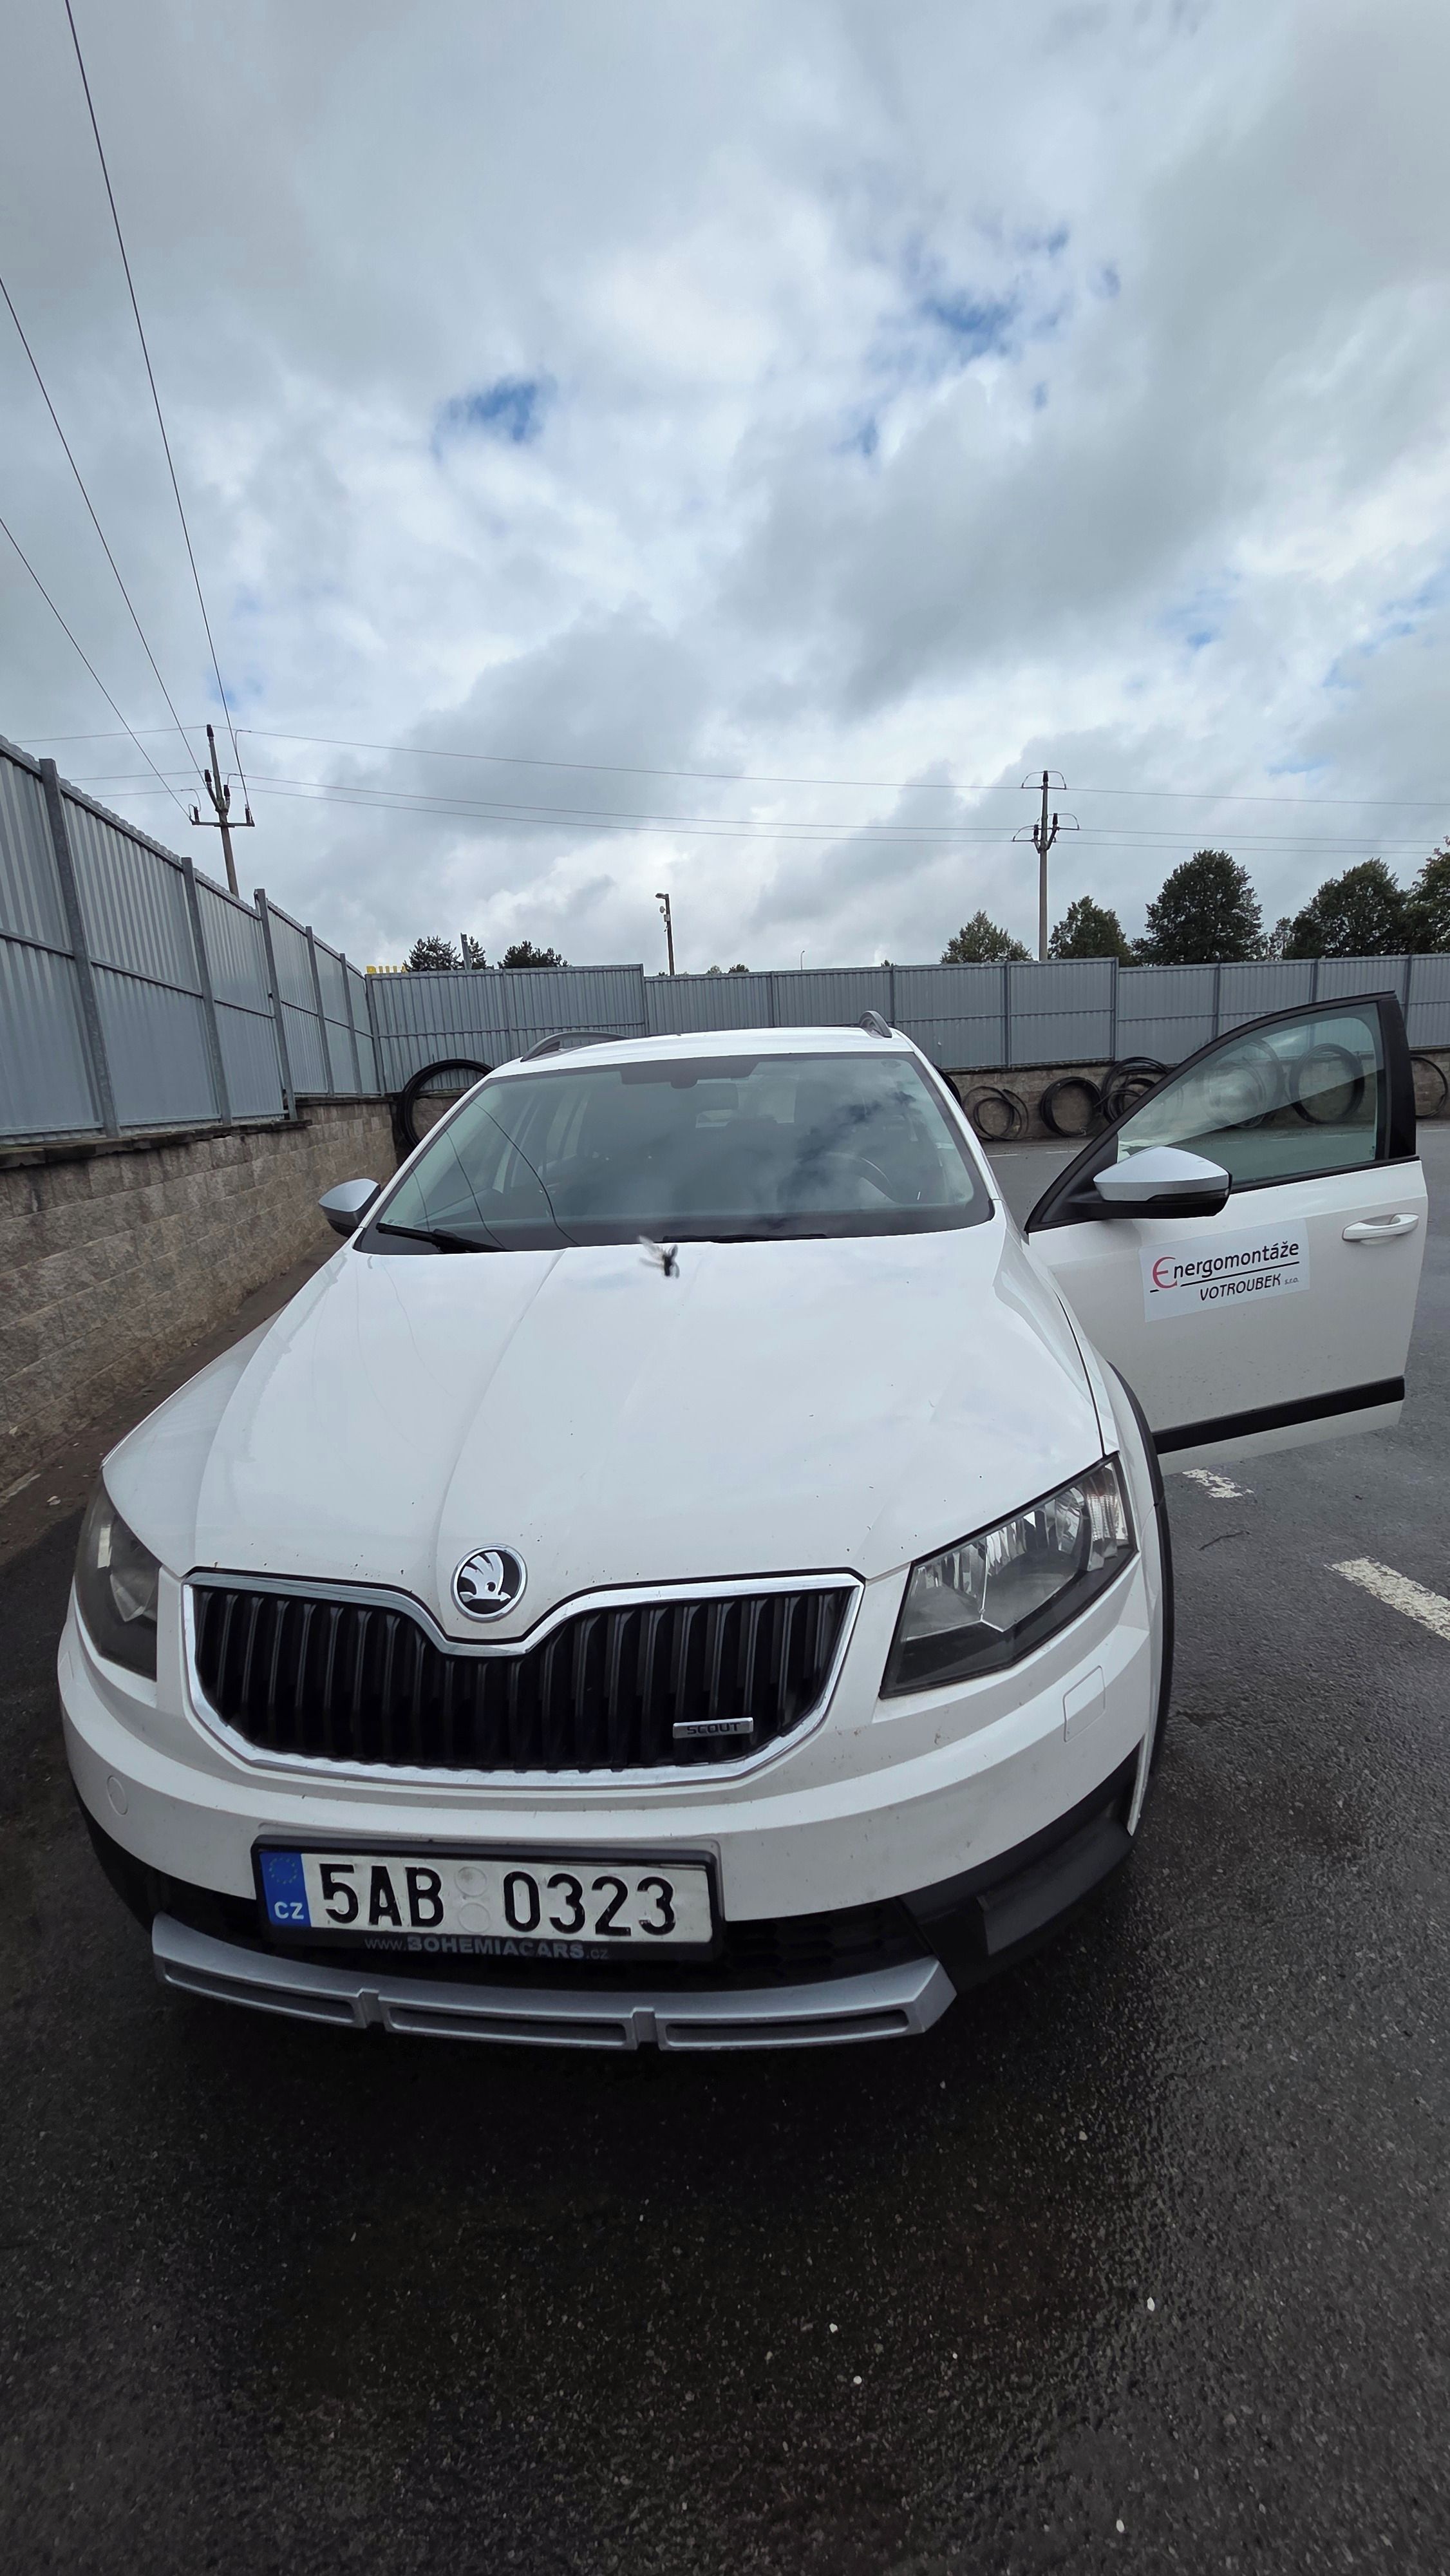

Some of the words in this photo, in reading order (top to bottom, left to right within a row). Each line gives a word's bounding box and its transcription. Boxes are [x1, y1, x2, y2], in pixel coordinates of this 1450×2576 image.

[1152, 1240, 1299, 1289] Energomontáže
[1200, 1273, 1281, 1301] VOTROUBEK
[687, 1722, 740, 1735] SCOUT
[274, 1902, 305, 1919] CZ
[319, 1863, 445, 1927] 5AB
[503, 1871, 677, 1937] 0323
[364, 1935, 609, 1960] www.BOHEMIACARS.cz
